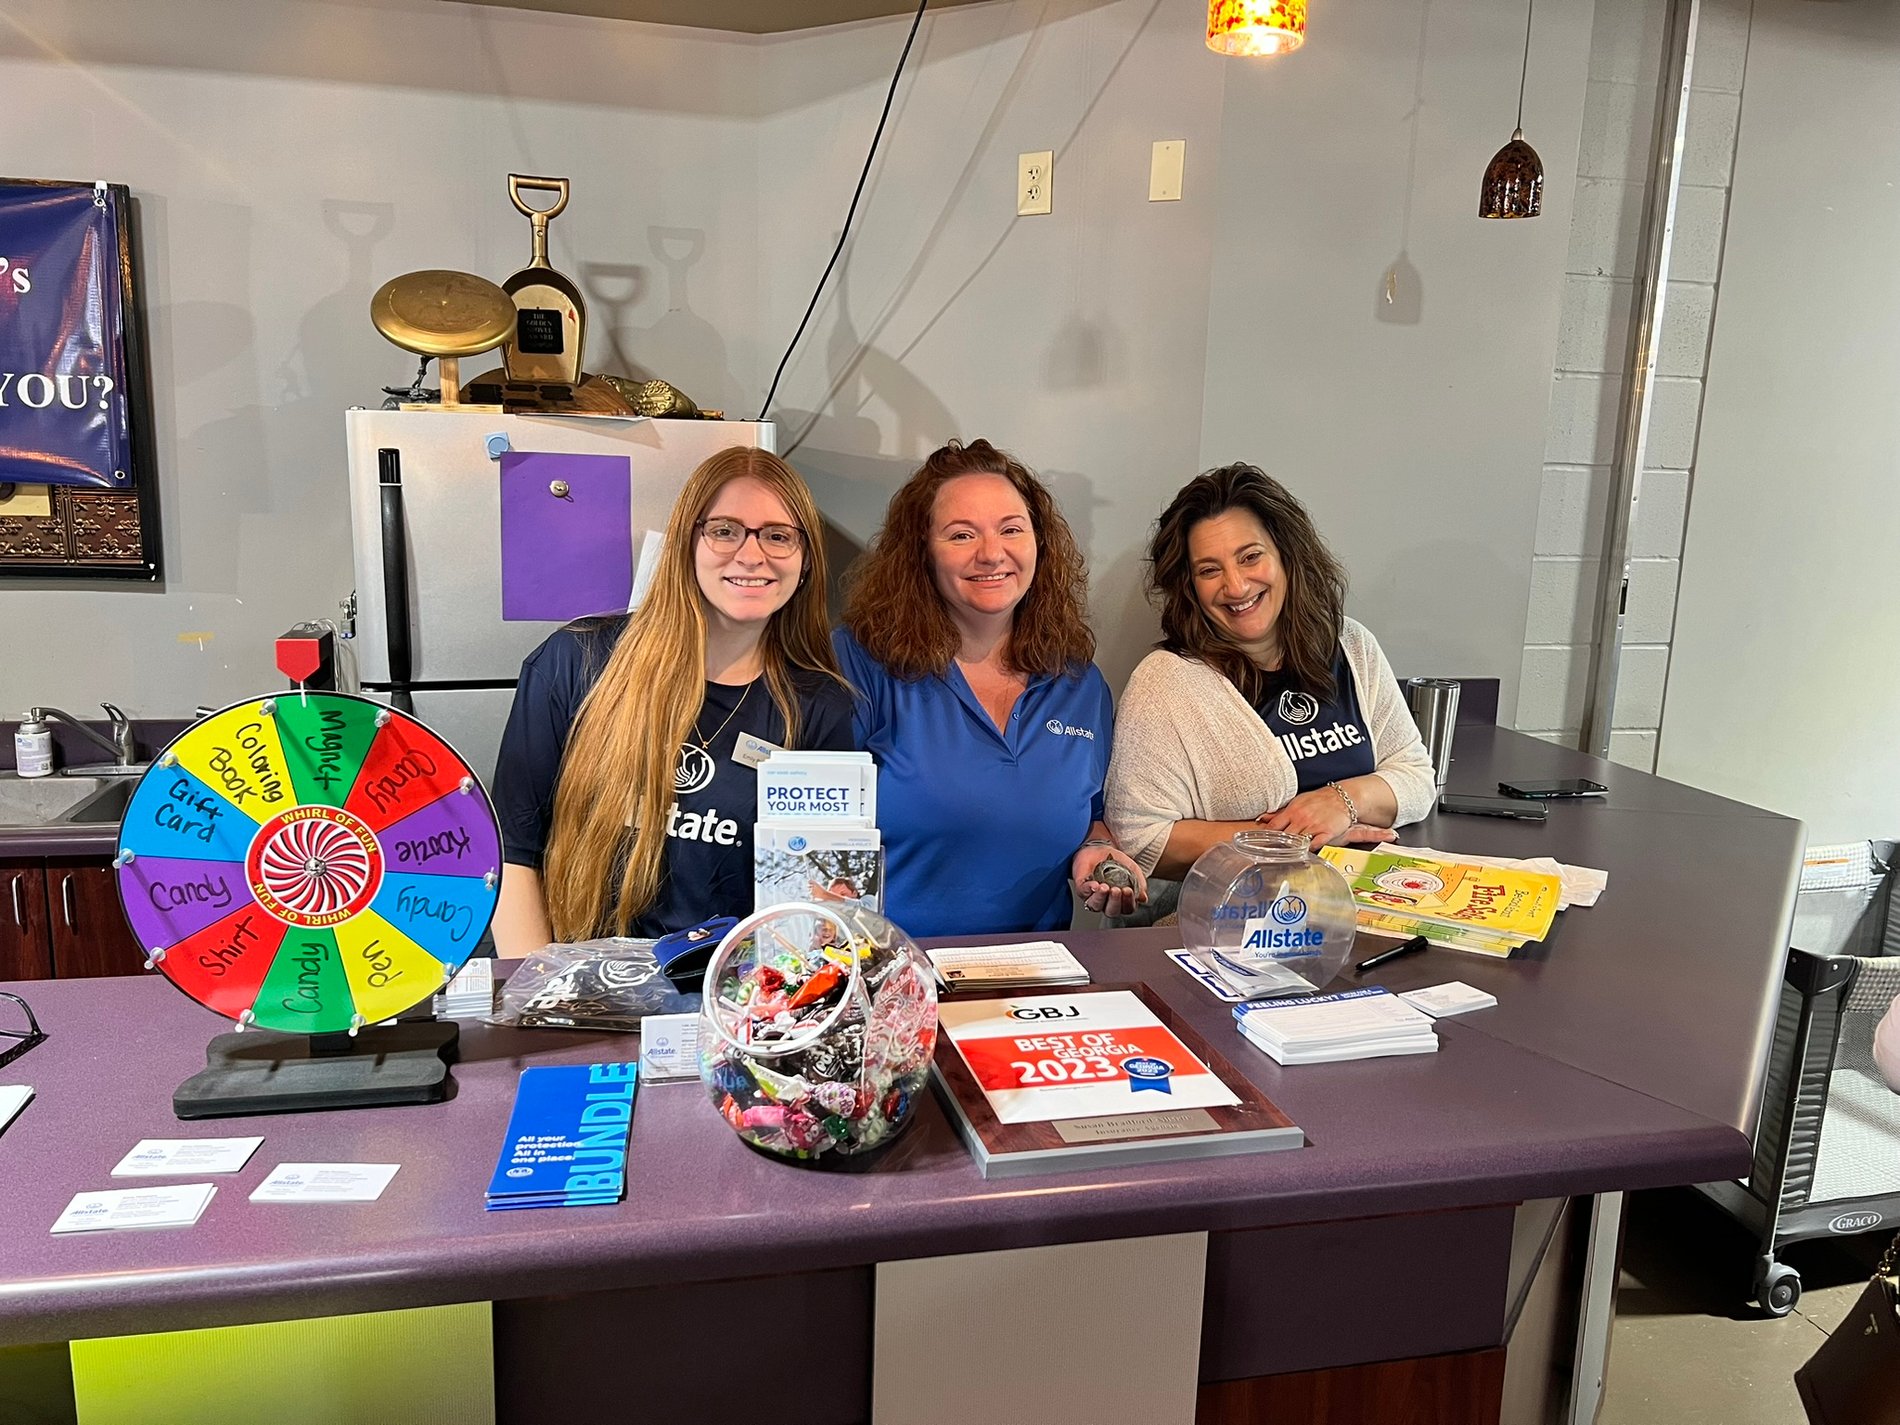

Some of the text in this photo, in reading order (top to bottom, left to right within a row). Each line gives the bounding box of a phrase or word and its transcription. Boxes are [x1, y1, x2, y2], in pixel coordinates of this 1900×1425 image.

[305, 710, 347, 791] Magnet
[1276, 721, 1366, 762] llstate.
[235, 722, 285, 804] Coloring
[364, 749, 437, 815] Candy
[168, 778, 224, 820] Gift
[766, 786, 850, 800] PROTECT
[767, 801, 850, 812] YOUR MOST
[154, 803, 216, 844] Card
[280, 807, 378, 853] WHIRL OF FUN
[394, 826, 472, 866] Koozie
[149, 873, 233, 912] Candy
[253, 883, 352, 925] WHIRL OF FUN
[396, 885, 473, 943] Candy
[198, 915, 260, 977] Shirt
[1243, 928, 1324, 949] Allstate
[281, 941, 330, 1015] Candy
[1013, 1005, 1081, 1020] GBJ
[1246, 994, 1340, 1010] FEELING LUCKY?
[1013, 1032, 1116, 1052] BEST OF
[1053, 1043, 1144, 1059] GEORGIA
[1010, 1056, 1119, 1083] 2023
[1128, 1063, 1165, 1071] GEORGIA
[537, 1136, 567, 1144] your
[563, 1061, 638, 1193] BUNDLE
[537, 1155, 576, 1164] place.
[1836, 1214, 1877, 1230] GRACO
